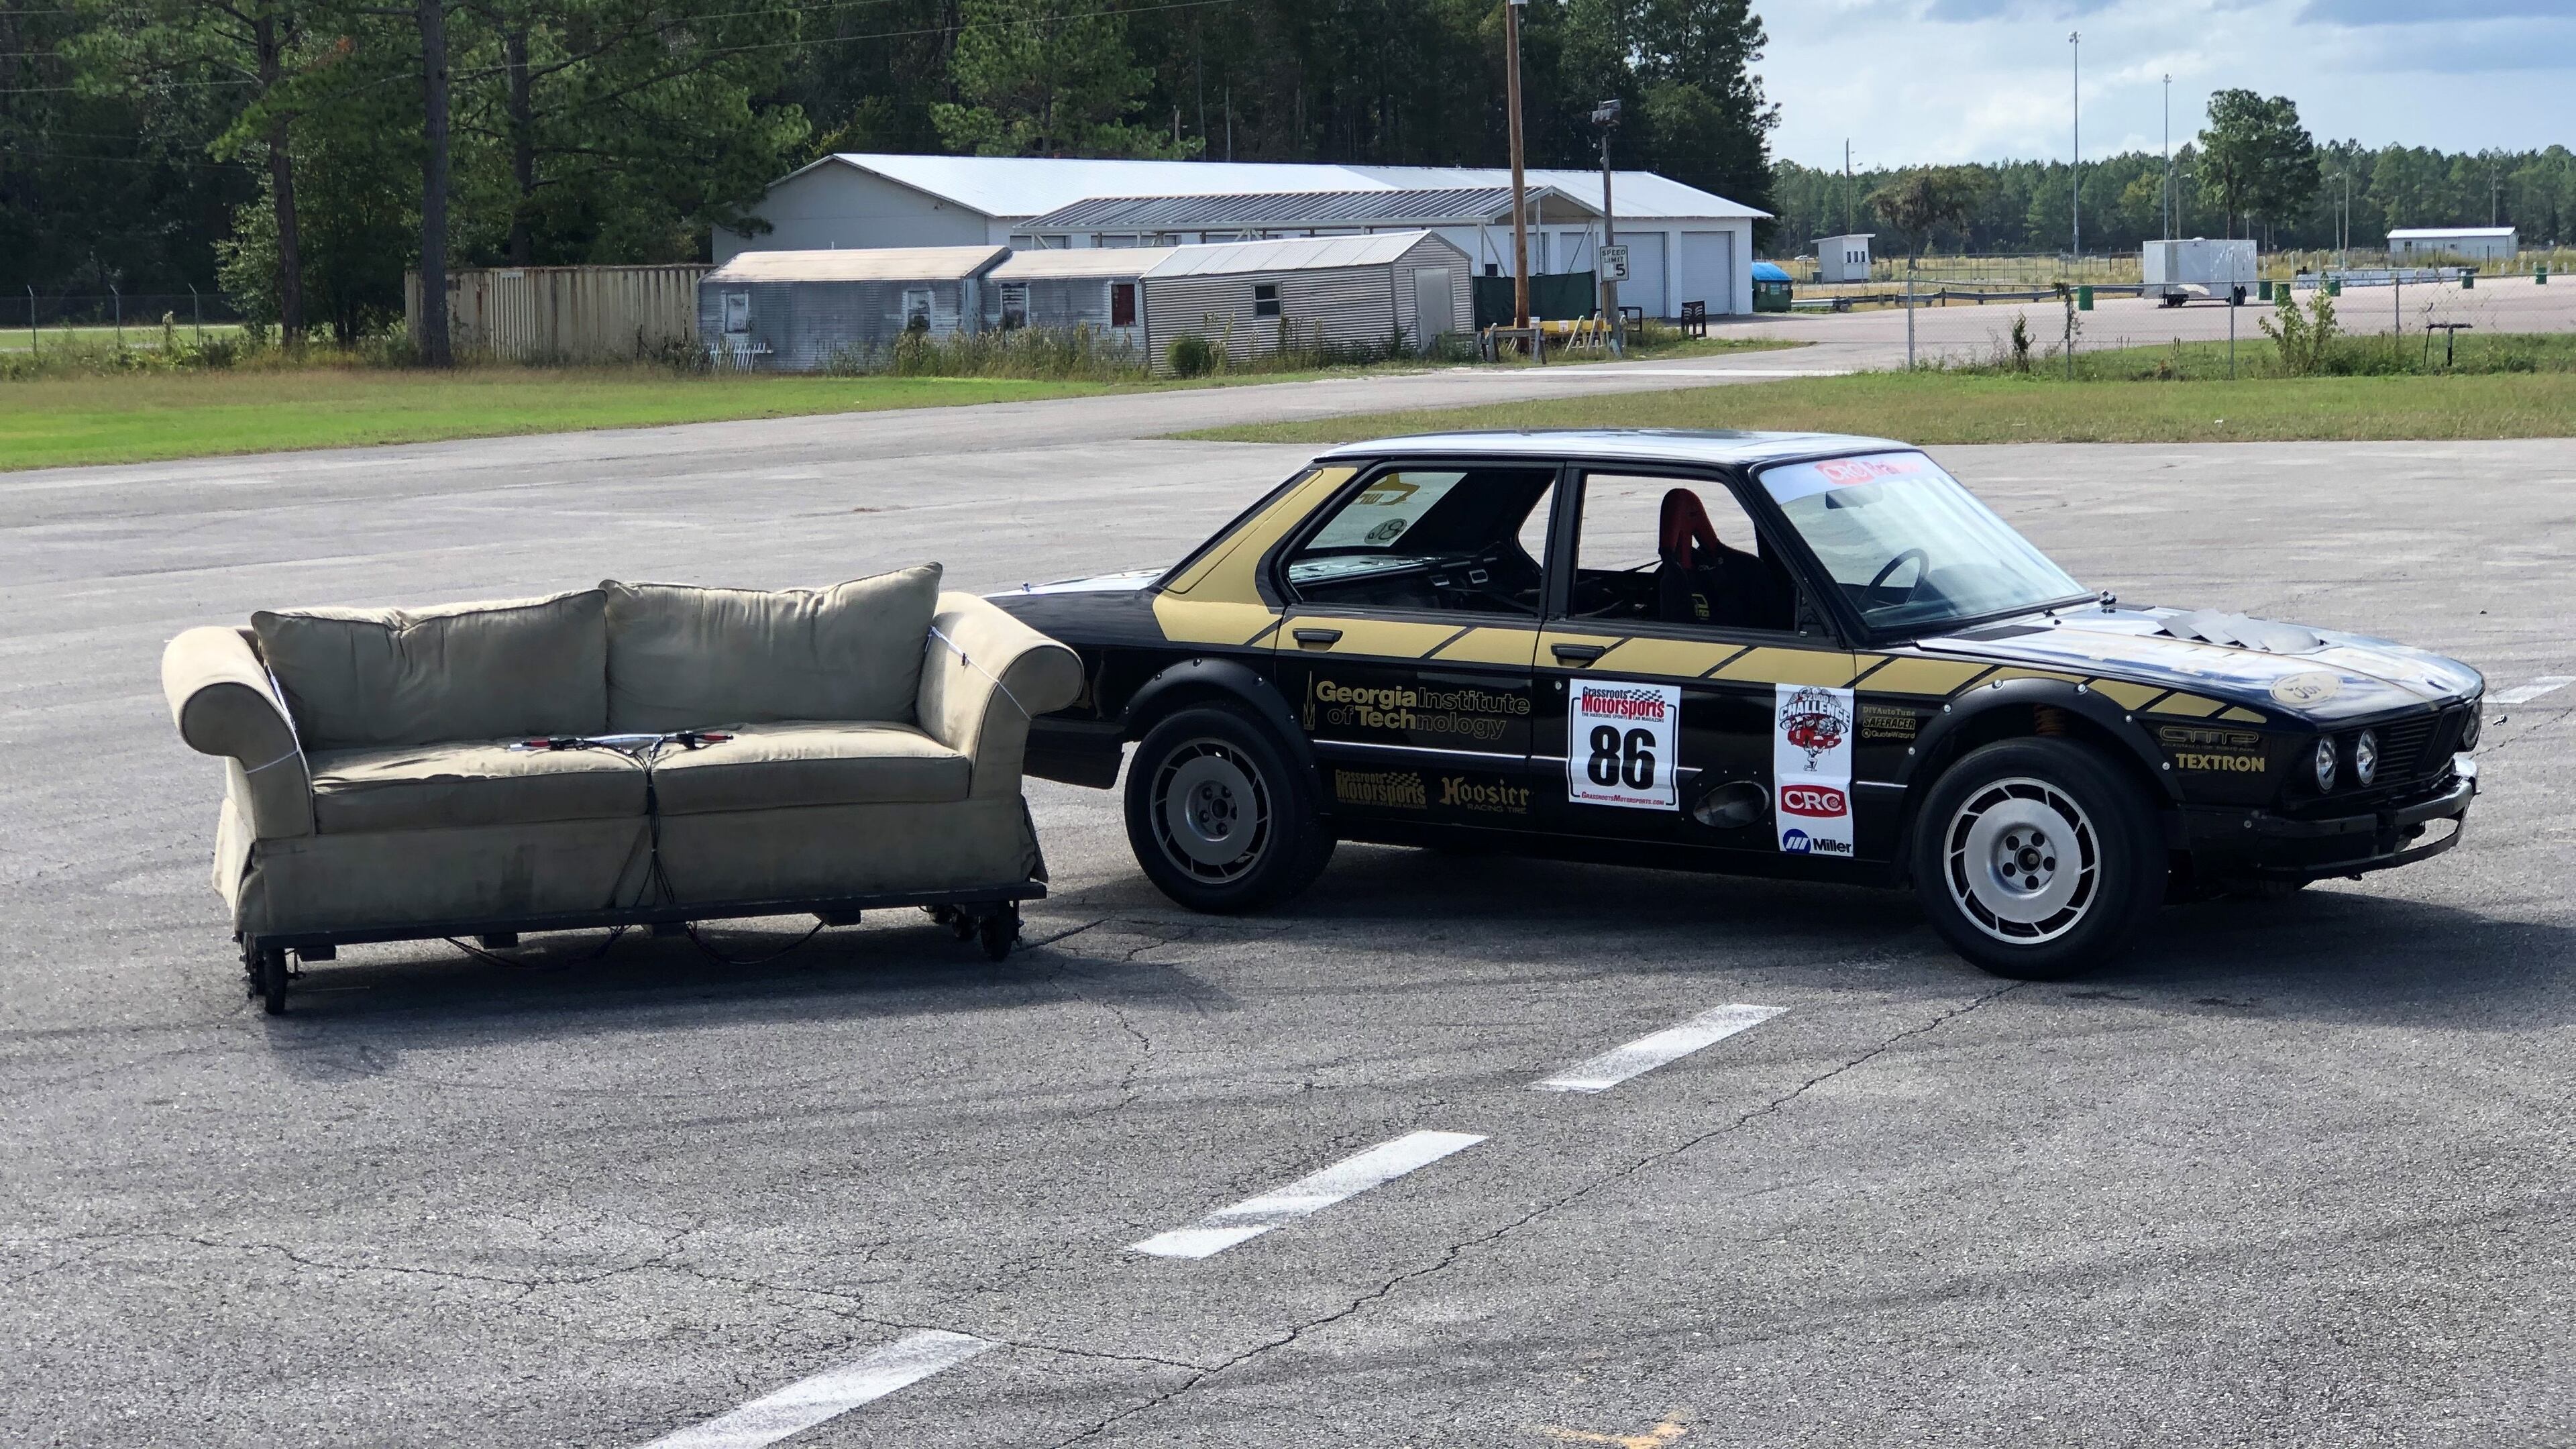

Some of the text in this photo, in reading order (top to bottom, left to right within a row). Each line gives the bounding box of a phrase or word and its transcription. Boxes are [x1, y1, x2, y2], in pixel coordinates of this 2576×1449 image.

[1316, 680, 1530, 715] Georgia Institute
[1583, 686, 1627, 699] Grassroots
[1581, 694, 1666, 720] Motorsports
[1779, 701, 1851, 728] CHALLENGE
[1327, 705, 1507, 739] of Technology
[1587, 725, 1656, 790] 86
[2176, 753, 2265, 772] TEXTRON
[1335, 769, 1385, 784] Grassroots
[1336, 778, 1427, 806] Motorsports
[1439, 776, 1530, 806] Hoosier
[1784, 790, 1842, 812] CRC
[1467, 804, 1527, 814] RACING TIRE
[1813, 838, 1851, 854] Miller
